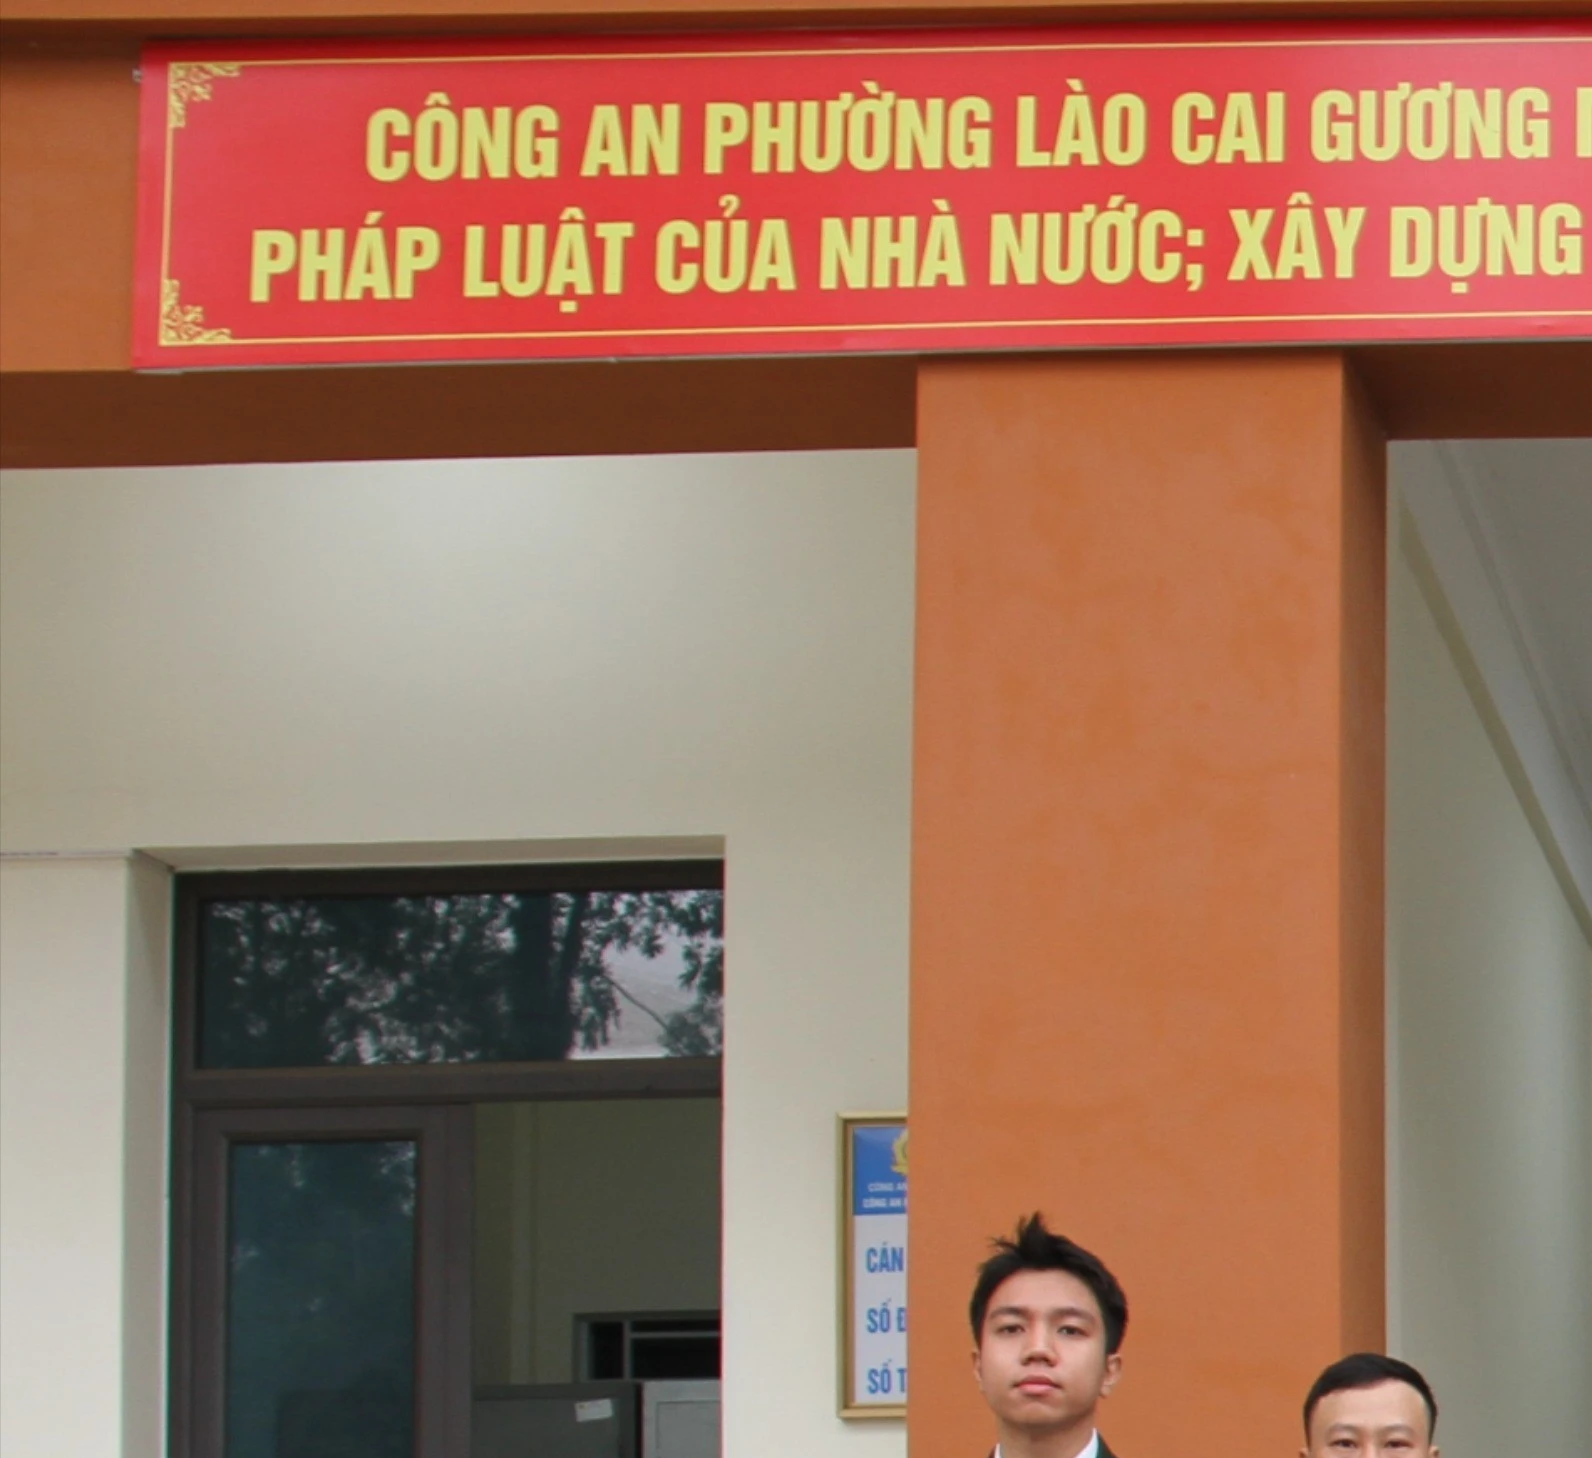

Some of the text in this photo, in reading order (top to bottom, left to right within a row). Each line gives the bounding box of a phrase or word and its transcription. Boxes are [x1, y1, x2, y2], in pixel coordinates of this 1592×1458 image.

[368, 93, 558, 181] CÔNG
[582, 104, 679, 176] AN
[705, 82, 991, 173] PHƯỜNG
[1017, 79, 1145, 166] LÀO
[1172, 92, 1284, 164] CAI
[1311, 81, 1550, 162] GƯƠNG
[252, 212, 439, 301] PHÁP
[465, 208, 633, 312] LUẬT
[657, 195, 796, 293] CỦA
[821, 199, 965, 289] NHÀ
[990, 196, 1203, 290] NƯỚC;
[1228, 192, 1366, 280] XÂY
[1390, 197, 1582, 293] DỰNG
[867, 1297, 891, 1334] SỐ
[867, 1358, 892, 1395] SỐ
